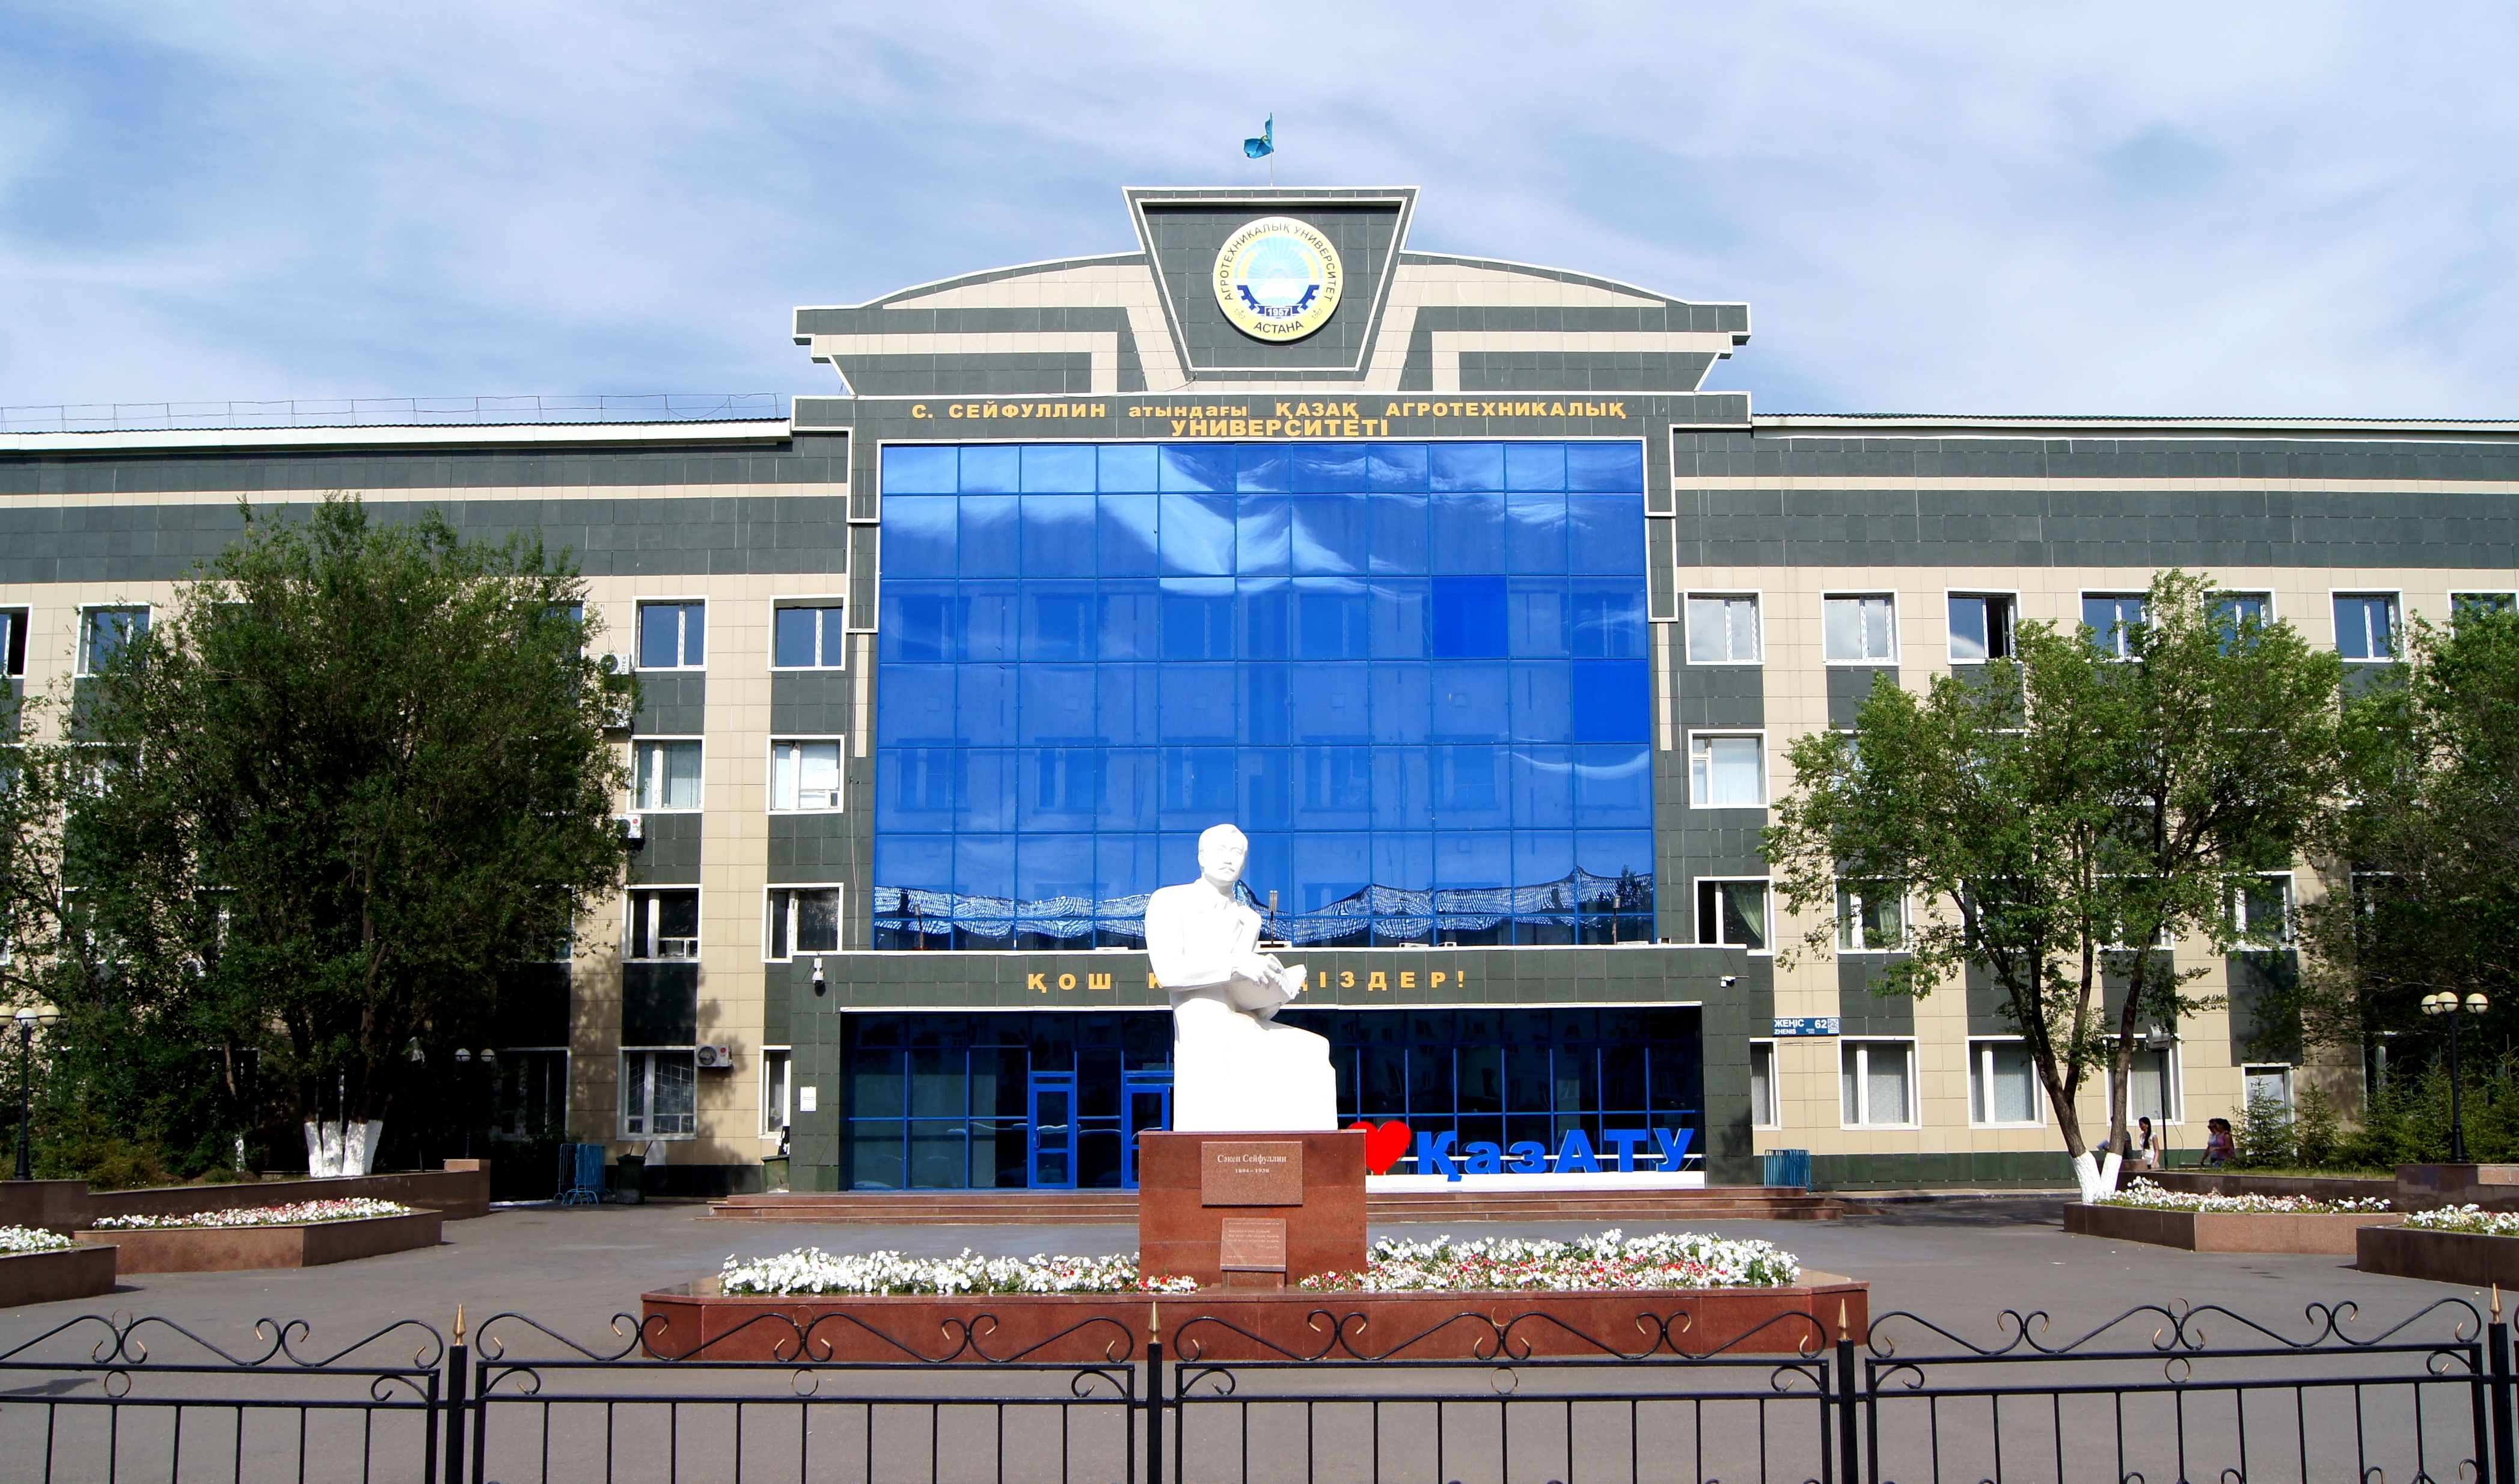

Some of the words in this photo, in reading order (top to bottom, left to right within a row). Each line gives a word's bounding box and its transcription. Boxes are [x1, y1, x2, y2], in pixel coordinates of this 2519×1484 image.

[1220, 223, 1291, 301] АГРОТЕХНИКАЛЫҚ
[1294, 225, 1336, 302] УНИВЕРСИТЕТ
[1267, 308, 1290, 316] 1957
[1253, 320, 1305, 334] АСТАНА
[913, 404, 934, 419] С.
[949, 402, 1106, 418] СЕЙФУЛЛИН
[1129, 406, 1247, 420] атындағы
[1276, 402, 1360, 420] ҚАЗАҚ
[1385, 402, 1626, 420] АГРОТЕХНИКАЛЫҚ
[1171, 420, 1388, 437] УНИВЕРСИТЕТІ
[1027, 973, 1111, 994] ҚОШ
[1774, 1019, 1805, 1028] ЖЕҢІС
[1814, 1019, 1828, 1029] 62
[1217, 1155, 1241, 1163] Сәкен
[1242, 1154, 1287, 1164] Сейфуллин
[1416, 1128, 1695, 1182] ҚазАТУ
